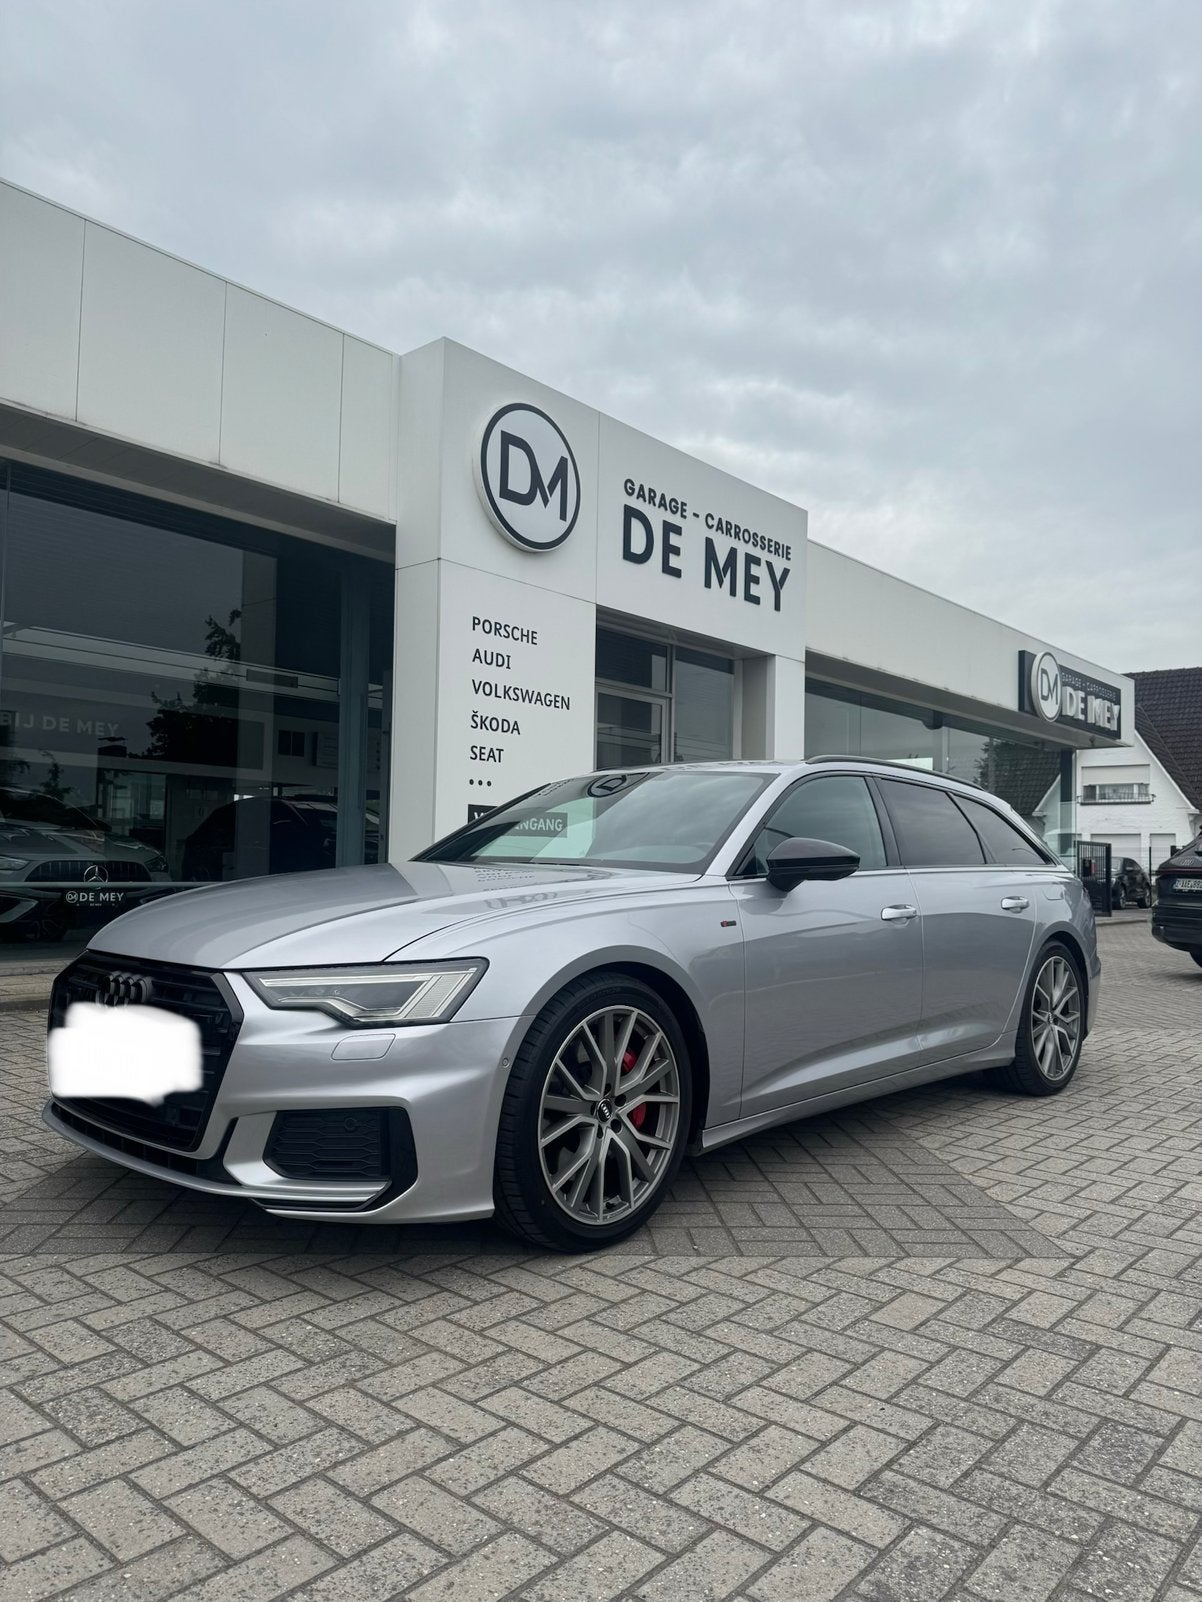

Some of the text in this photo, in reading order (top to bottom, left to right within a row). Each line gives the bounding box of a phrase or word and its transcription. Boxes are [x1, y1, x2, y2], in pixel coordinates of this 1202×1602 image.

[499, 429, 569, 522] DM
[623, 478, 688, 519] GARAGE
[705, 512, 792, 561] CARROSSERIE
[622, 503, 791, 612] DE MEY
[472, 616, 538, 646] PORSCHE
[472, 648, 511, 670] AUDI
[471, 679, 570, 711] VOLKSWAGEN
[1061, 686, 1120, 731] DE MEY
[42, 715, 70, 733] DE
[76, 719, 119, 737] MEY
[470, 710, 521, 735] ŠKODA
[469, 745, 504, 763] SEAT
[79, 892, 95, 902] DE
[99, 892, 124, 902] MEY
